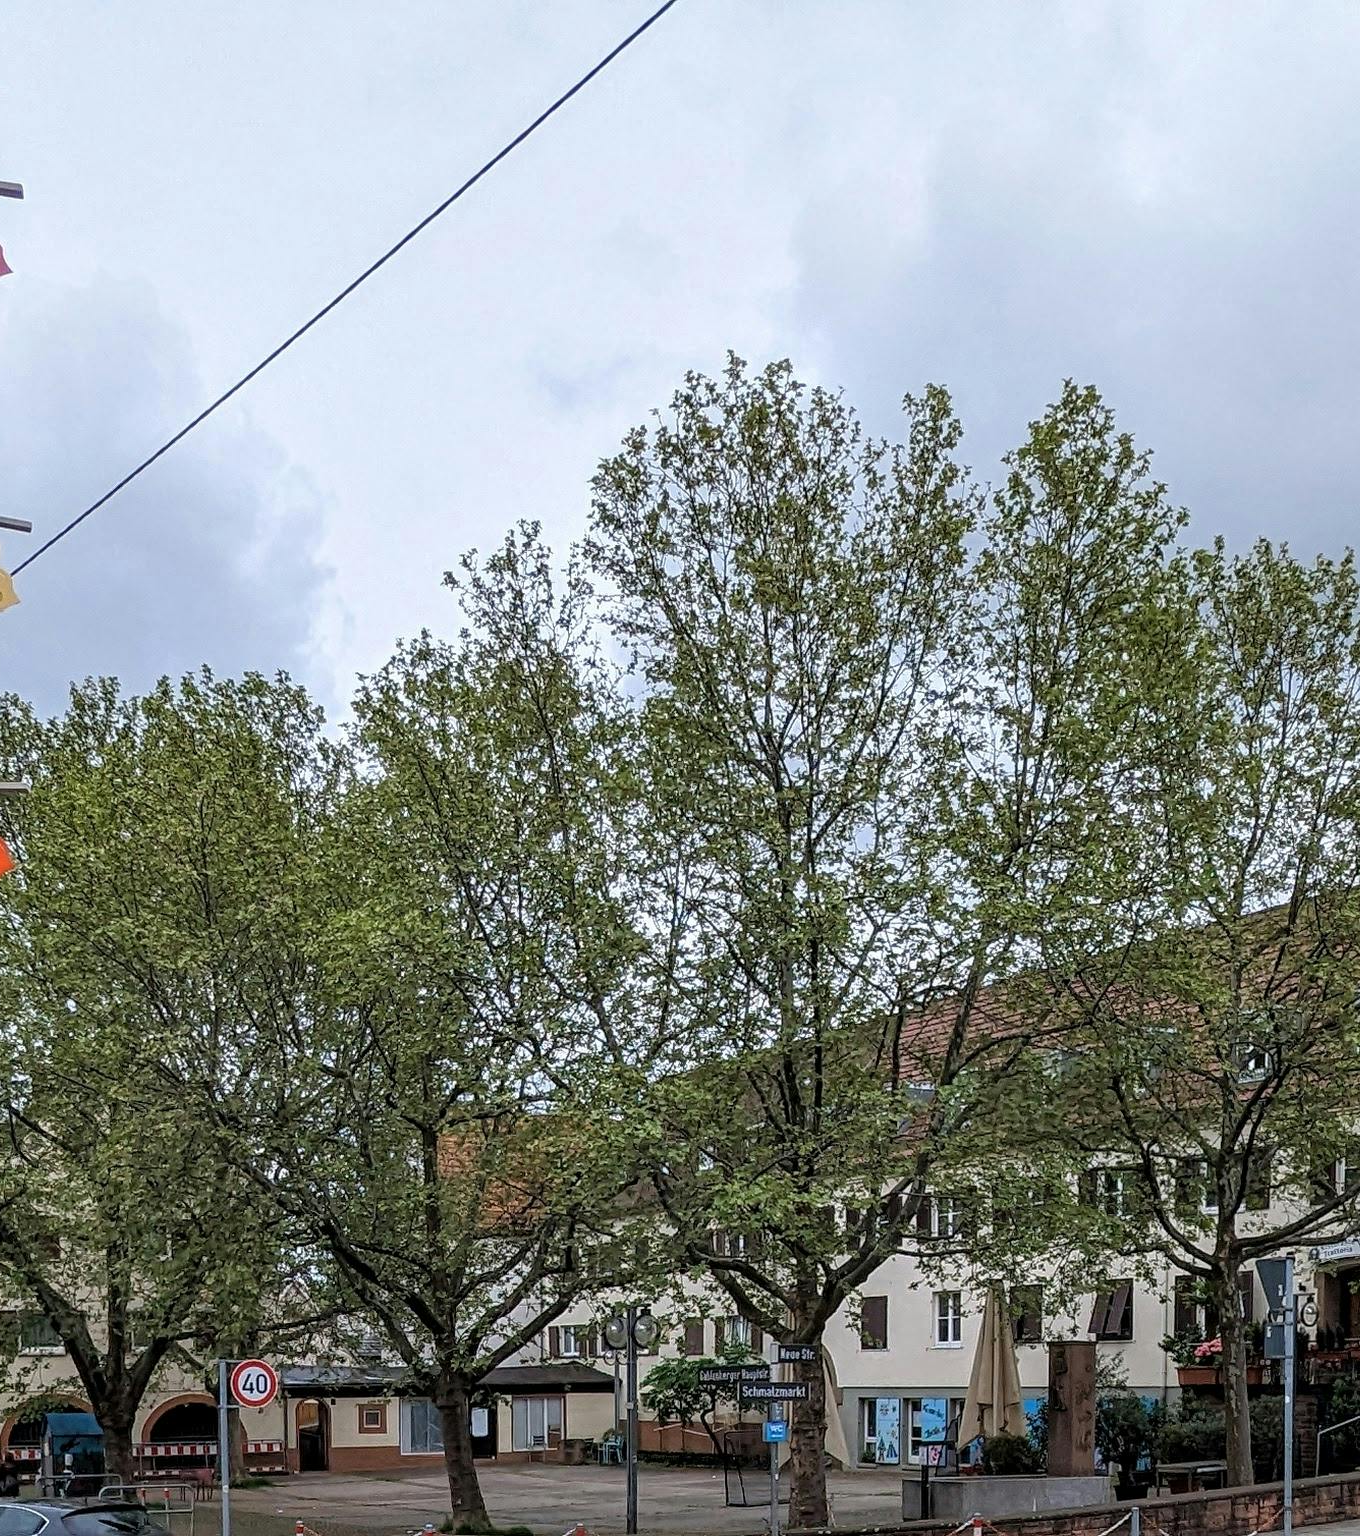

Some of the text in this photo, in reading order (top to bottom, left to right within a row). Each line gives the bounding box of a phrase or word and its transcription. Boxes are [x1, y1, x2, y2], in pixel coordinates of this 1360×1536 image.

[800, 1347, 816, 1360] Str.
[242, 1373, 267, 1394] 40
[742, 1386, 807, 1399] Schmalzmarkt
[770, 1424, 783, 1433] WC
